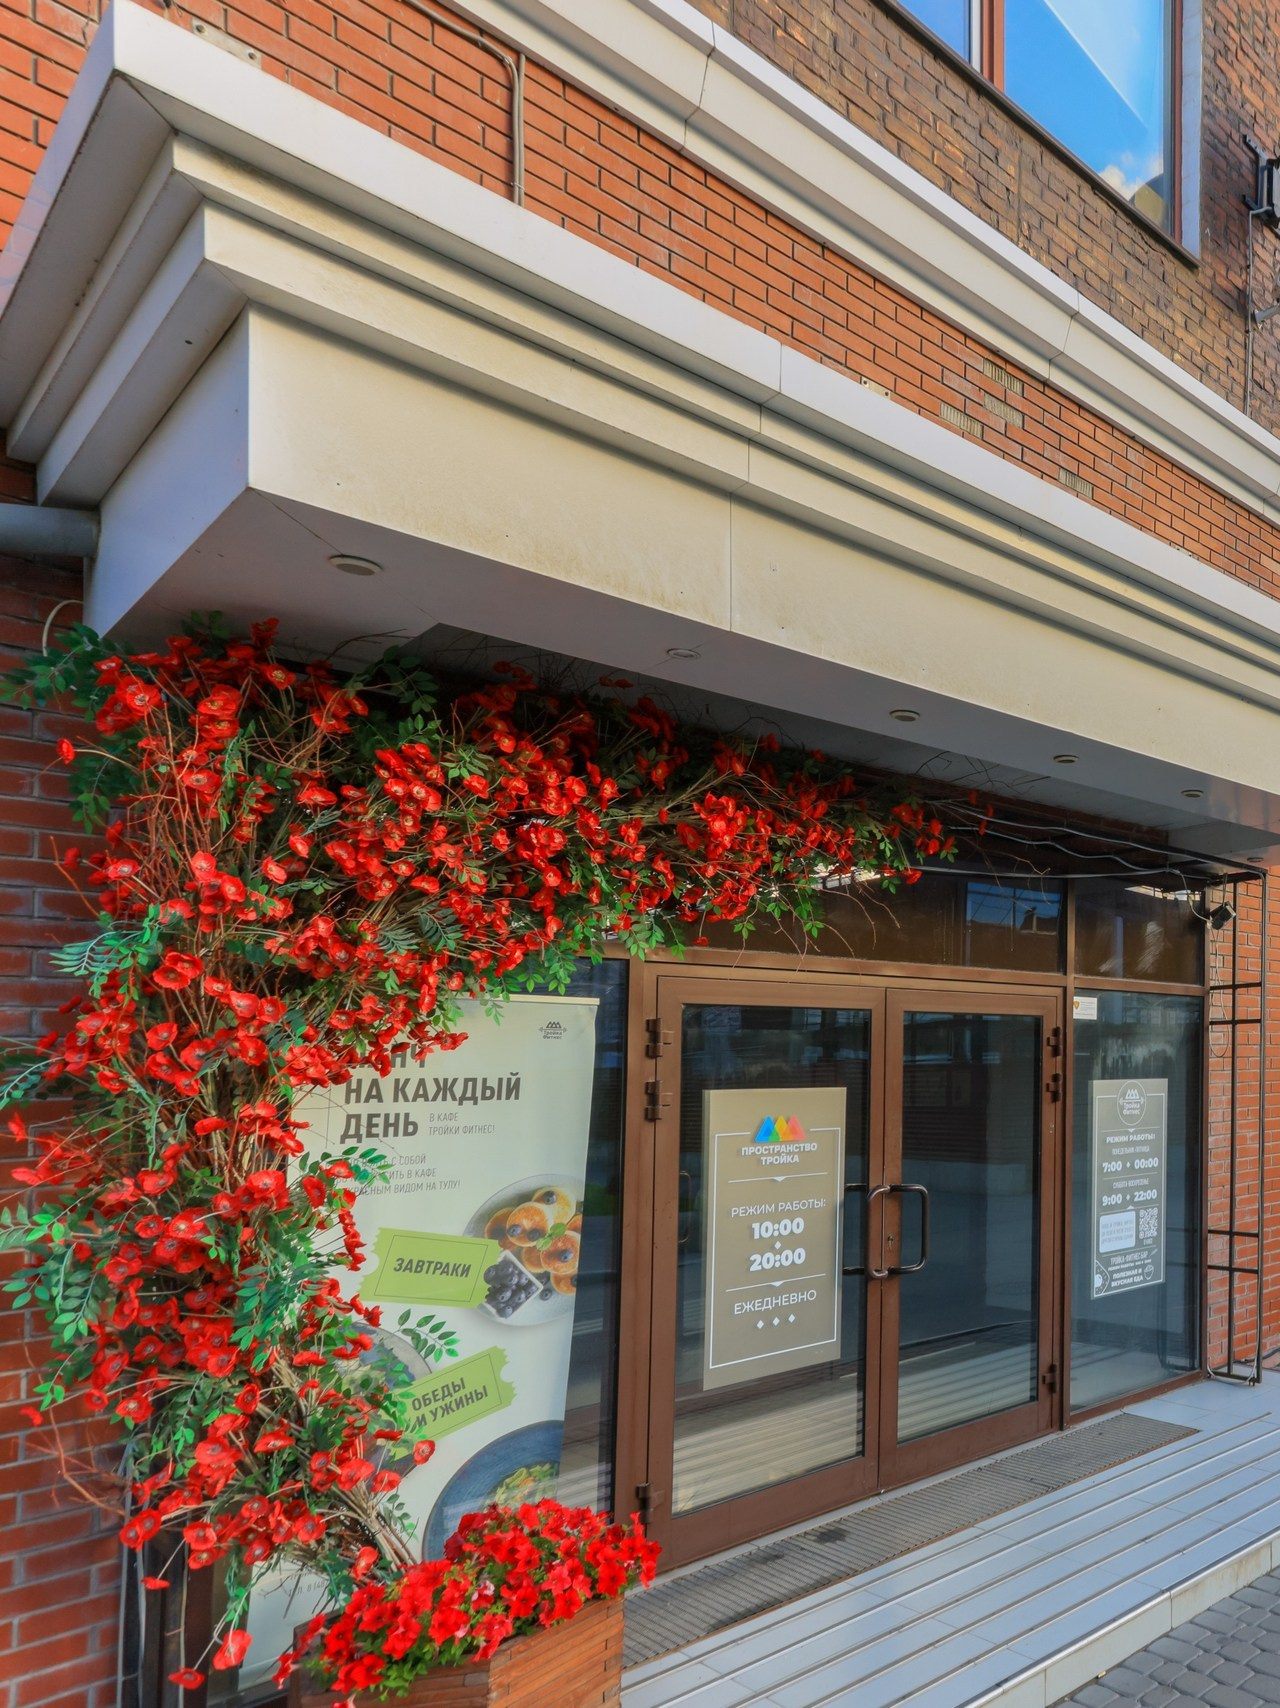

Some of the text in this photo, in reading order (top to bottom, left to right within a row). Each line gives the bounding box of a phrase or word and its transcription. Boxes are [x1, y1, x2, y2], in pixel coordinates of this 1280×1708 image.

[345, 1072, 521, 1105] НА КАЖДЫЙ
[429, 1112, 459, 1122] В КАФЕ
[340, 1112, 418, 1145] ДЕНЬ
[428, 1124, 495, 1136] ТРОЙКИ ФИТНЕС!
[741, 1142, 818, 1156] ПРОСТРАНСТВО
[399, 1154, 426, 1166] СОБОЙ
[761, 1154, 800, 1166] ТРОЙКА
[1103, 1158, 1158, 1172] 7:00 00:00
[407, 1170, 412, 1179] В
[415, 1168, 437, 1178] КАФЕ
[394, 1183, 423, 1194] ВИДОМ
[426, 1182, 437, 1191] НА
[439, 1180, 461, 1190] ТУЛУ!
[1103, 1190, 1157, 1206] 9:00 22:00
[731, 1198, 827, 1218] РЕЖИМ РАБОТЫ:
[751, 1217, 805, 1240] 10:00
[393, 1258, 472, 1278] ЗАВТРАКИ
[749, 1248, 806, 1272] 20:00
[1111, 1278, 1132, 1287] ВКУСНАЯ
[733, 1290, 817, 1315] ЕЖЕДНЕВНО
[411, 1377, 466, 1411] ОБЕДЫ
[416, 1385, 489, 1428] И УЖИНЫ
